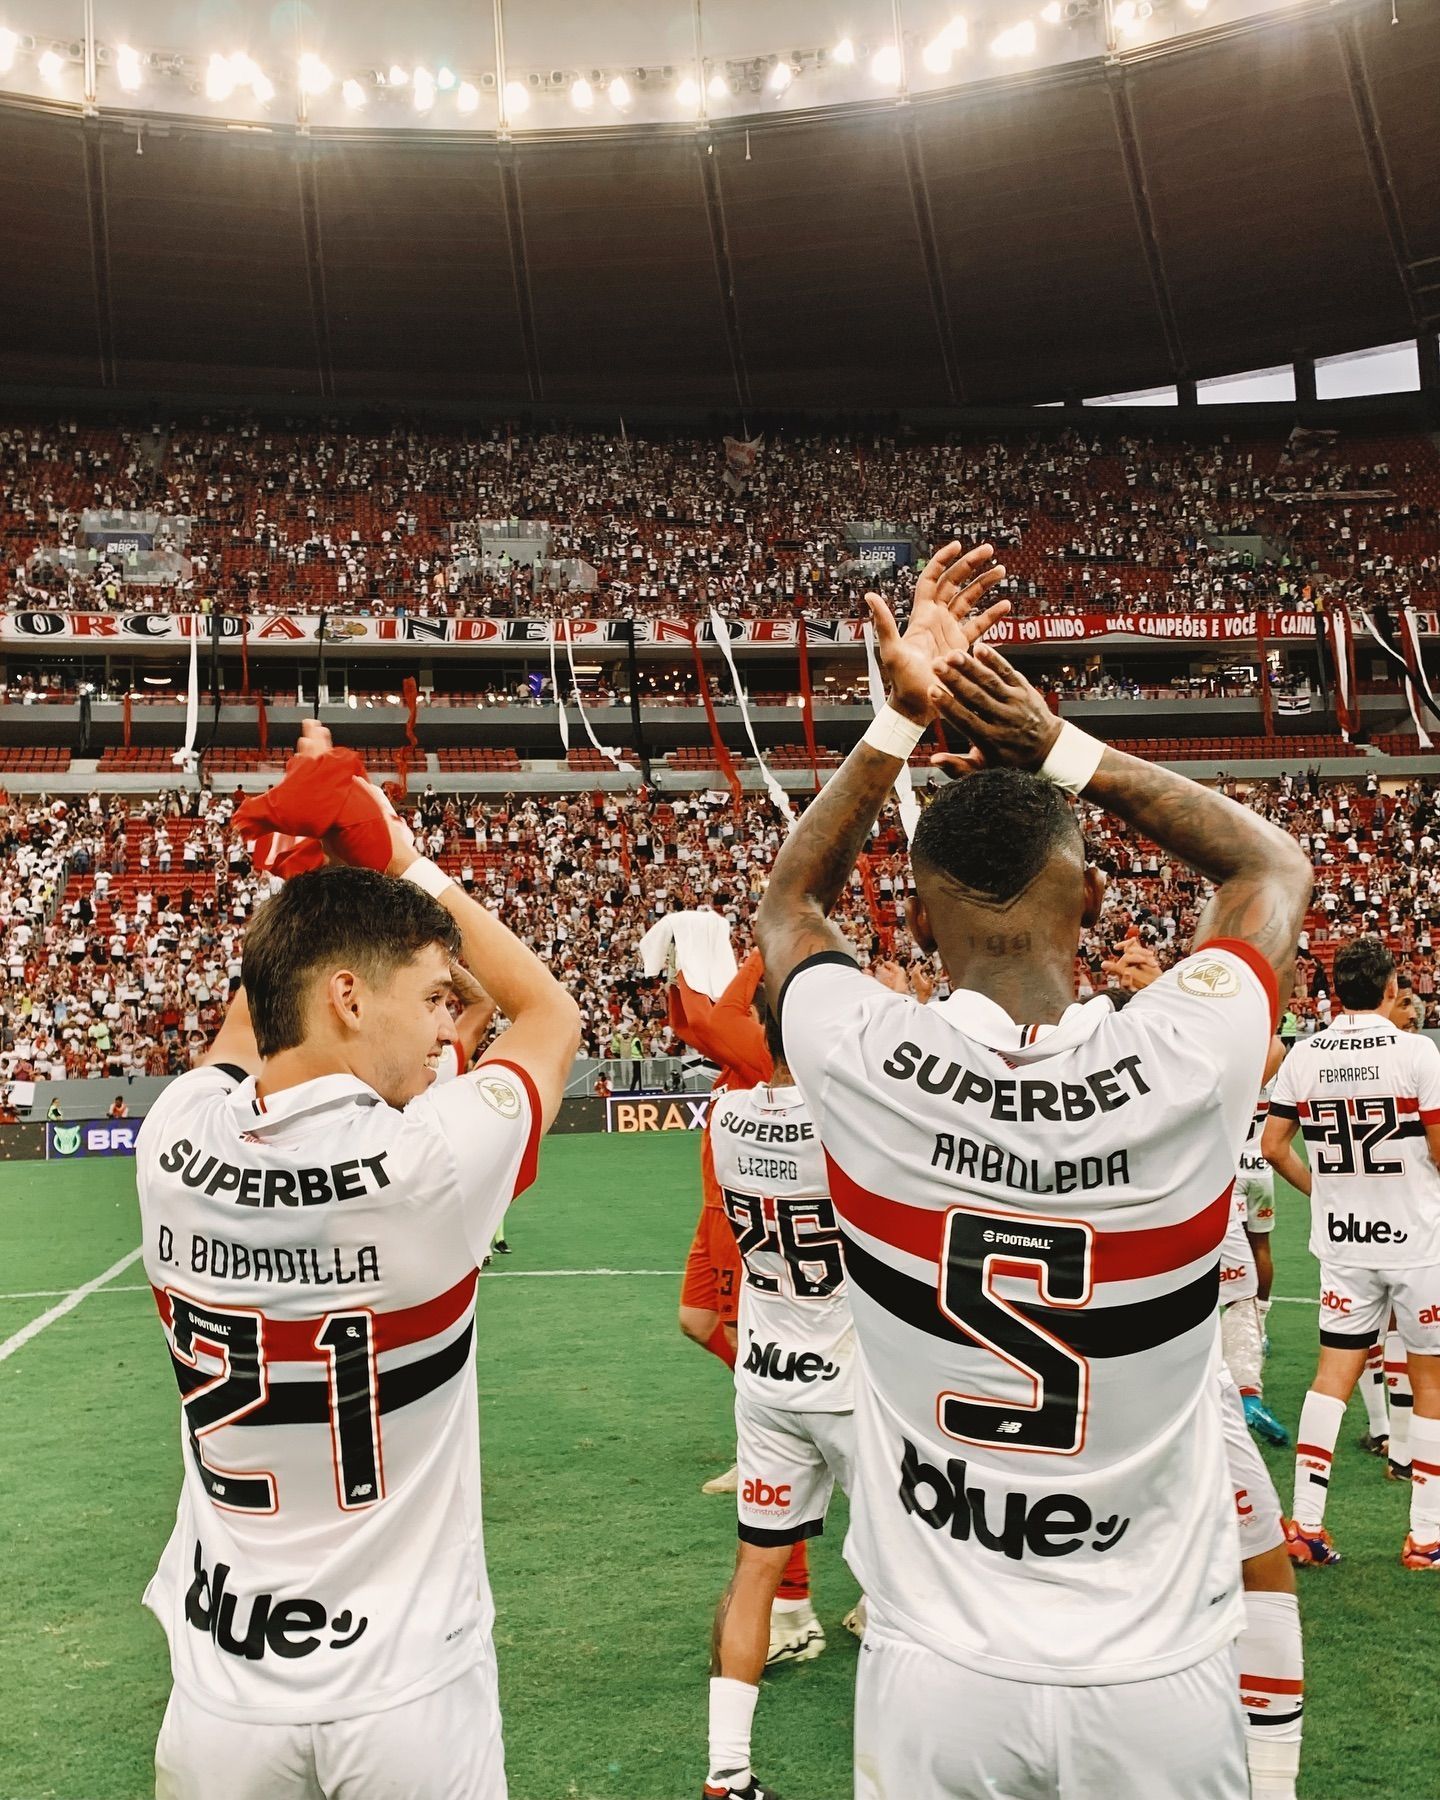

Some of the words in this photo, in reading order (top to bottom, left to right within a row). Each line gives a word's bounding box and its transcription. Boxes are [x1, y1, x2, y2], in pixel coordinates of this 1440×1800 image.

[0, 611, 307, 640] ORCIDA
[1018, 620, 1041, 640] FOI
[1043, 618, 1085, 638] LINDO
[1139, 615, 1208, 638] CAMPEÕES
[1211, 618, 1220, 637] E
[1310, 1035, 1398, 1051] SUPERBET
[882, 1040, 1152, 1122] SUPERBET
[617, 1101, 709, 1133] BRAX
[720, 1111, 815, 1143] SUPERBE
[87, 1128, 138, 1151] BR
[1307, 1094, 1405, 1177] 32
[159, 1138, 391, 1208] SUPERBET
[1239, 1152, 1265, 1170] lue
[720, 1183, 847, 1301] 26
[1328, 1212, 1391, 1244] blue
[158, 1224, 180, 1267] D.
[191, 1234, 380, 1285] BOBADILLA
[1321, 1290, 1353, 1314] abc
[936, 1203, 1097, 1457] 5
[163, 1287, 386, 1515] 21
[742, 1478, 792, 1507] abc
[899, 1436, 1092, 1561] blue
[184, 1539, 327, 1660] blue
